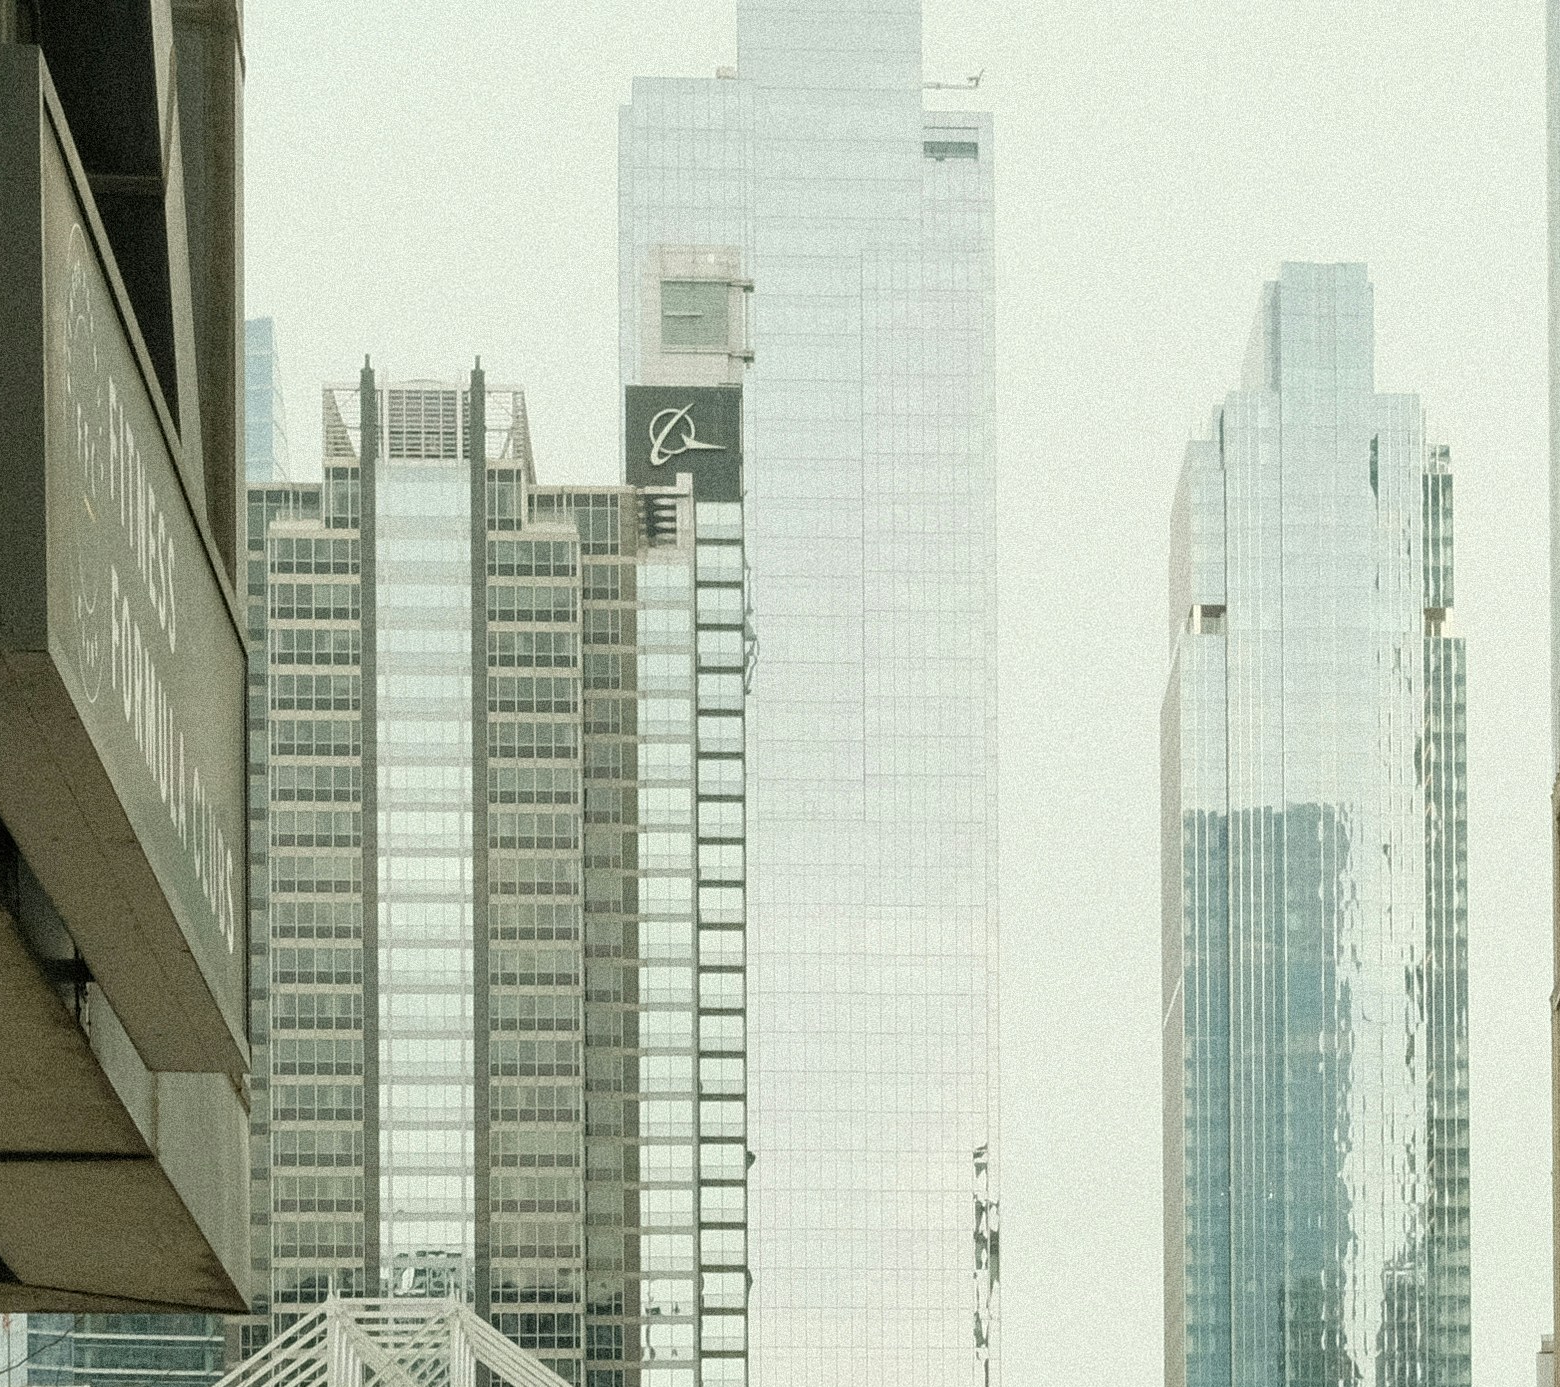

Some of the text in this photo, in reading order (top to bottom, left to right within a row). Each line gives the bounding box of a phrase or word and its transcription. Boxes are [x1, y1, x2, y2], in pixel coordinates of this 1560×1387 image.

[107, 375, 176, 654] FITNESS
[110, 563, 235, 955] FORMULA CLUBS
